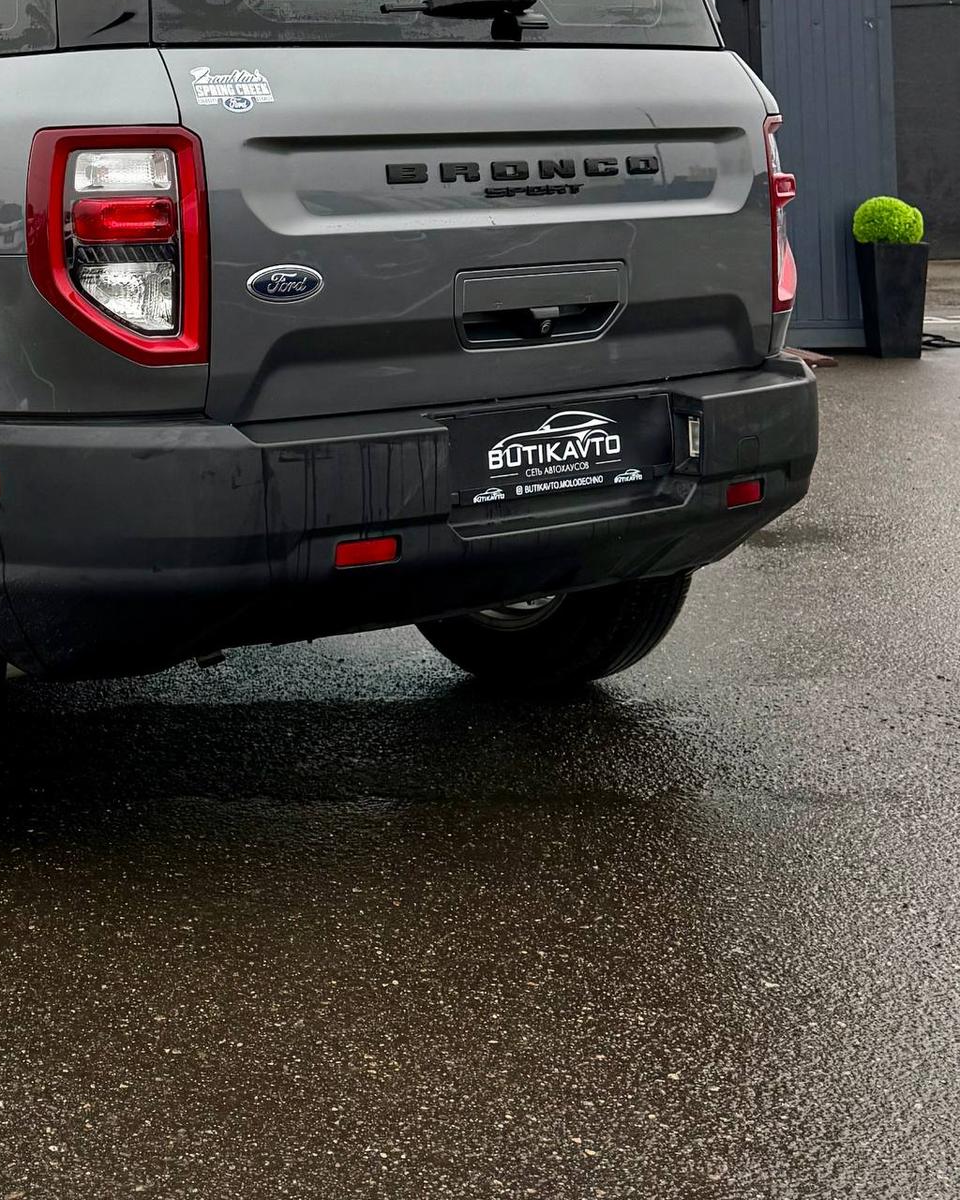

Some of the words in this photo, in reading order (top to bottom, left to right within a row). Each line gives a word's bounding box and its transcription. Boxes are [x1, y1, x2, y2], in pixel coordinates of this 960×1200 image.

[196, 84, 235, 97] SPRING
[236, 83, 271, 96] CREEK
[385, 155, 660, 185] BRONCO
[484, 183, 585, 198] SPORT
[266, 272, 307, 294] Ford
[488, 434, 621, 470] BUTIKAVTO
[525, 467, 543, 478] СЕТЬ
[544, 461, 590, 475] АВТОХАУСОВ
[524, 475, 604, 494] BUTIKAVTO.MOLODECHNO
